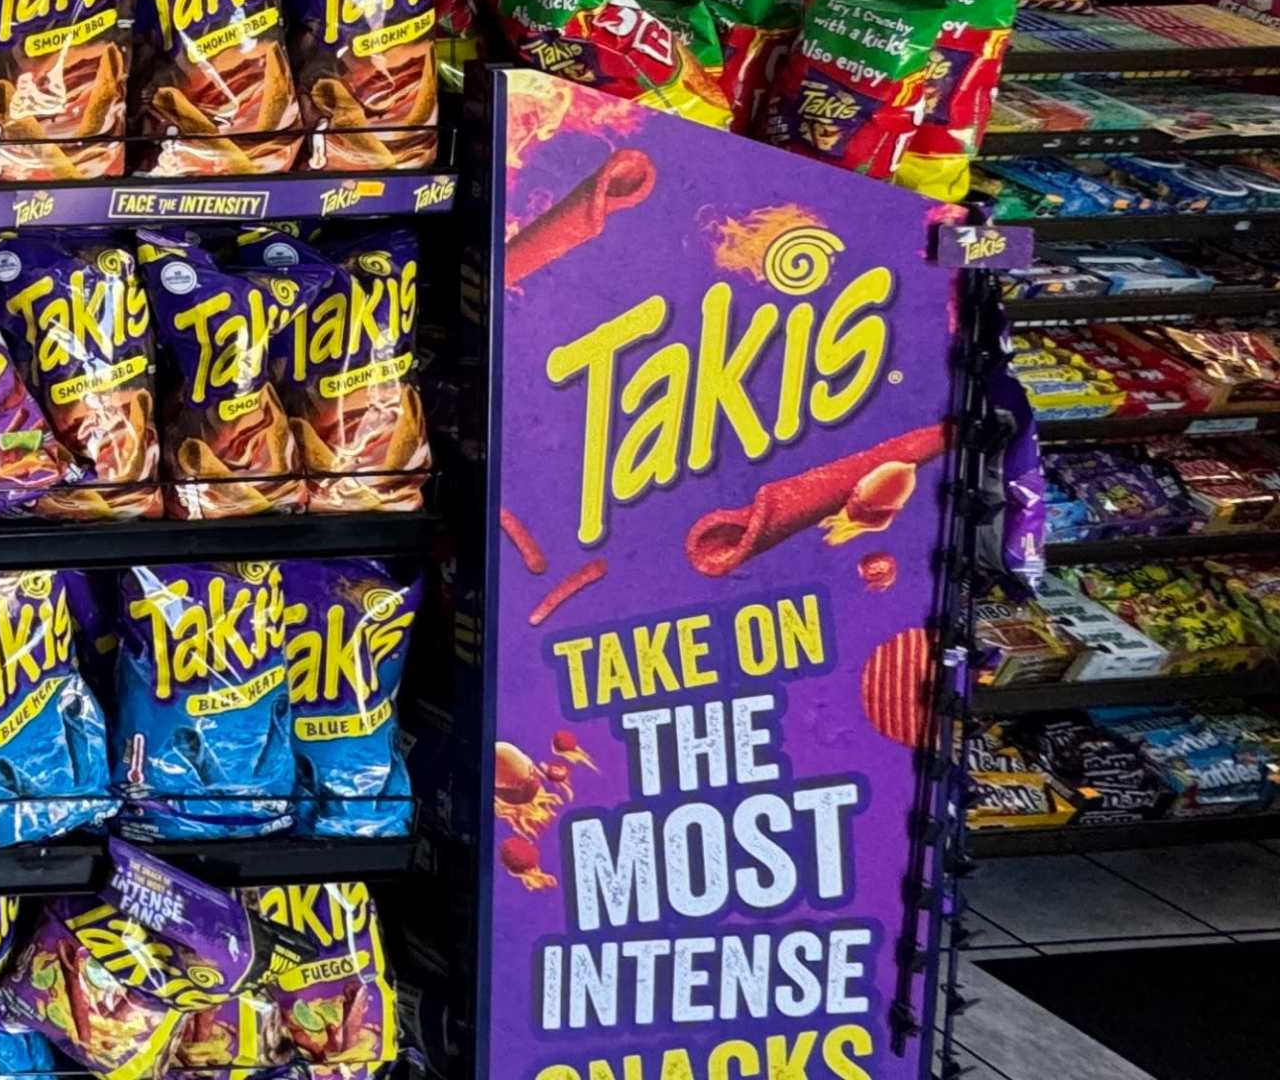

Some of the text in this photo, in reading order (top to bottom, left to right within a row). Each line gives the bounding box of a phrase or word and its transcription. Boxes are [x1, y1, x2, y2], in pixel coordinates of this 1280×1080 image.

[84, 16, 105, 34] BBQ
[814, 16, 846, 35] with
[850, 29, 858, 40] a
[864, 11, 914, 36] Crunchy
[836, 55, 888, 87] enjoy
[799, 90, 861, 120] Takis
[118, 193, 154, 214] FACE
[179, 190, 263, 213] INTENSITY
[320, 185, 361, 215] Takis
[414, 181, 456, 210] Takis
[13, 197, 54, 226] Takis
[964, 235, 1006, 265] Takis
[7, 269, 149, 380] Takis
[547, 266, 893, 543] Takis
[554, 594, 825, 710] TAKE ON
[1, 706, 31, 739] BLUE
[305, 719, 349, 737] BLUE
[623, 694, 779, 796] THE
[571, 785, 858, 931] MOST
[111, 873, 185, 920] INTENSE
[120, 895, 167, 932] FANS
[302, 958, 355, 983] FUEGO
[543, 929, 871, 1029] INTENSE
